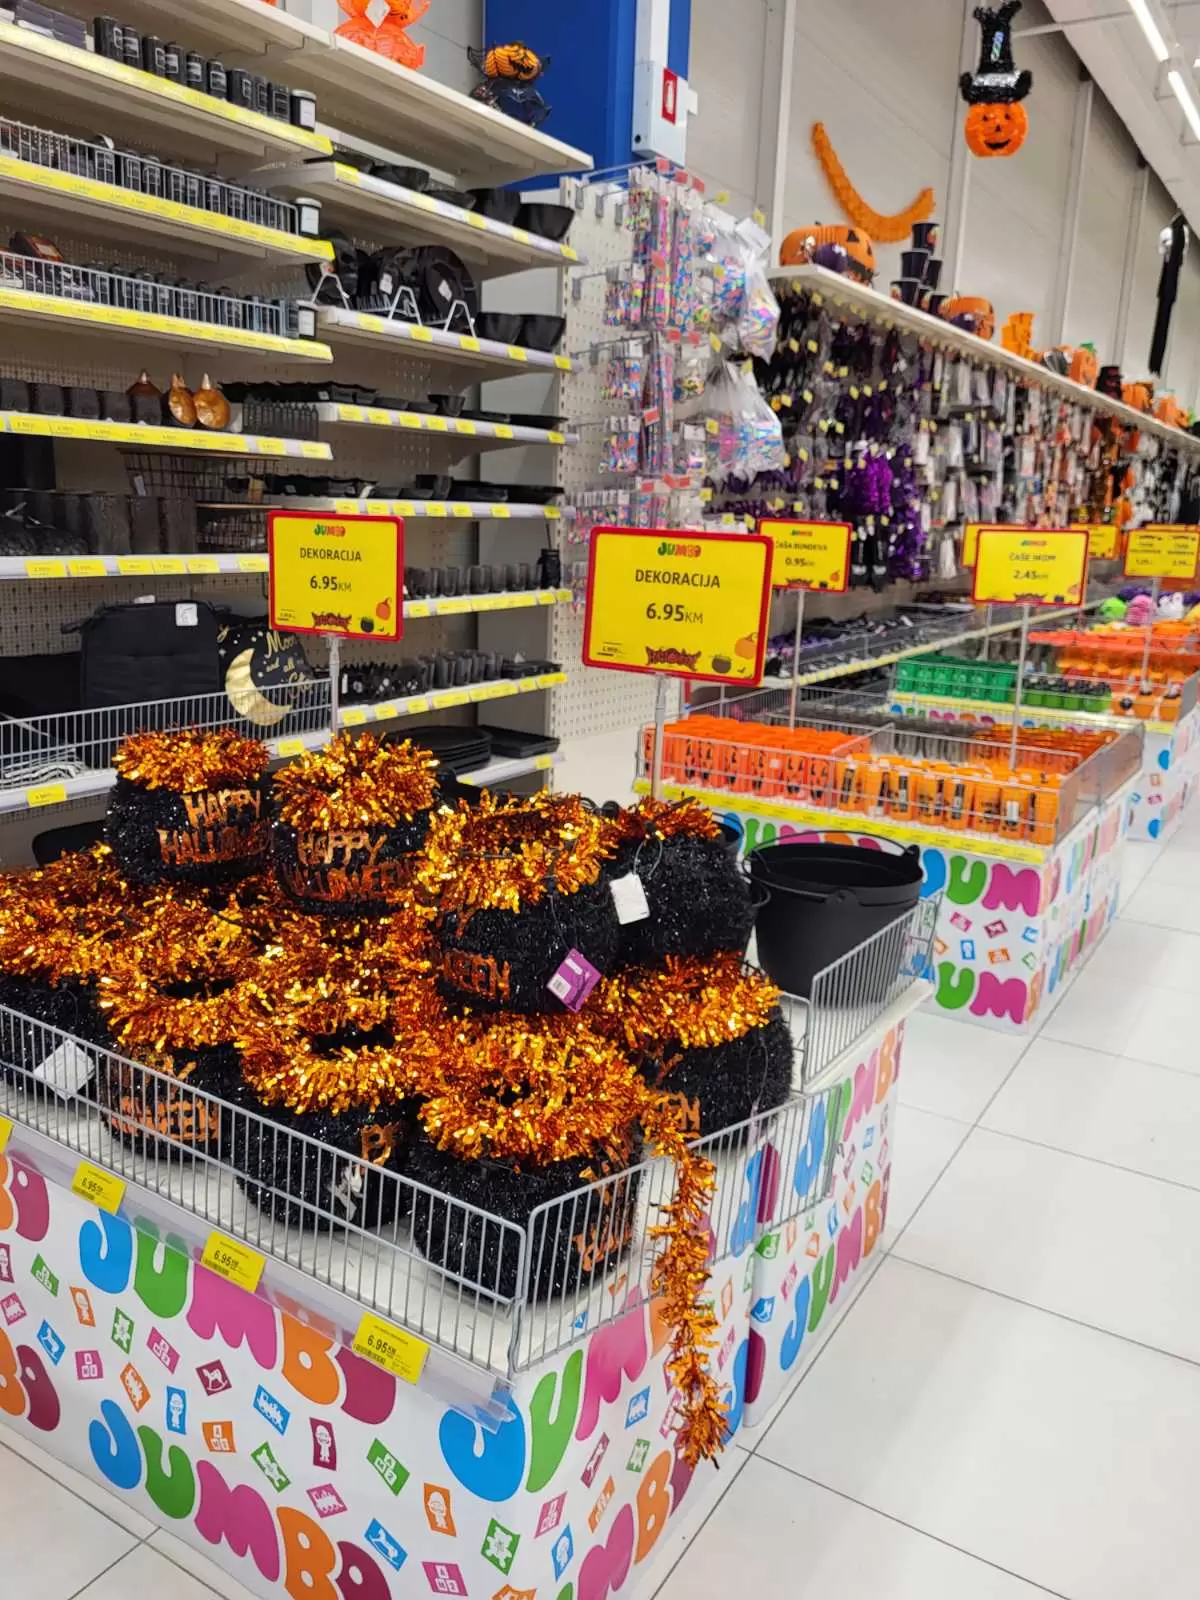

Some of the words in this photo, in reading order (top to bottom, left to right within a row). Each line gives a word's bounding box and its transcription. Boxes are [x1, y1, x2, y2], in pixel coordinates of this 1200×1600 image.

[299, 547, 362, 562] DEKORACIJA
[635, 569, 721, 588] DEKORACIJA
[181, 788, 261, 829] HAPPY
[297, 829, 388, 867] HAPPY
[213, 1249, 232, 1266] 6.95
[79, 1208, 396, 1425] JUMBO
[367, 1334, 389, 1354] 6.95
